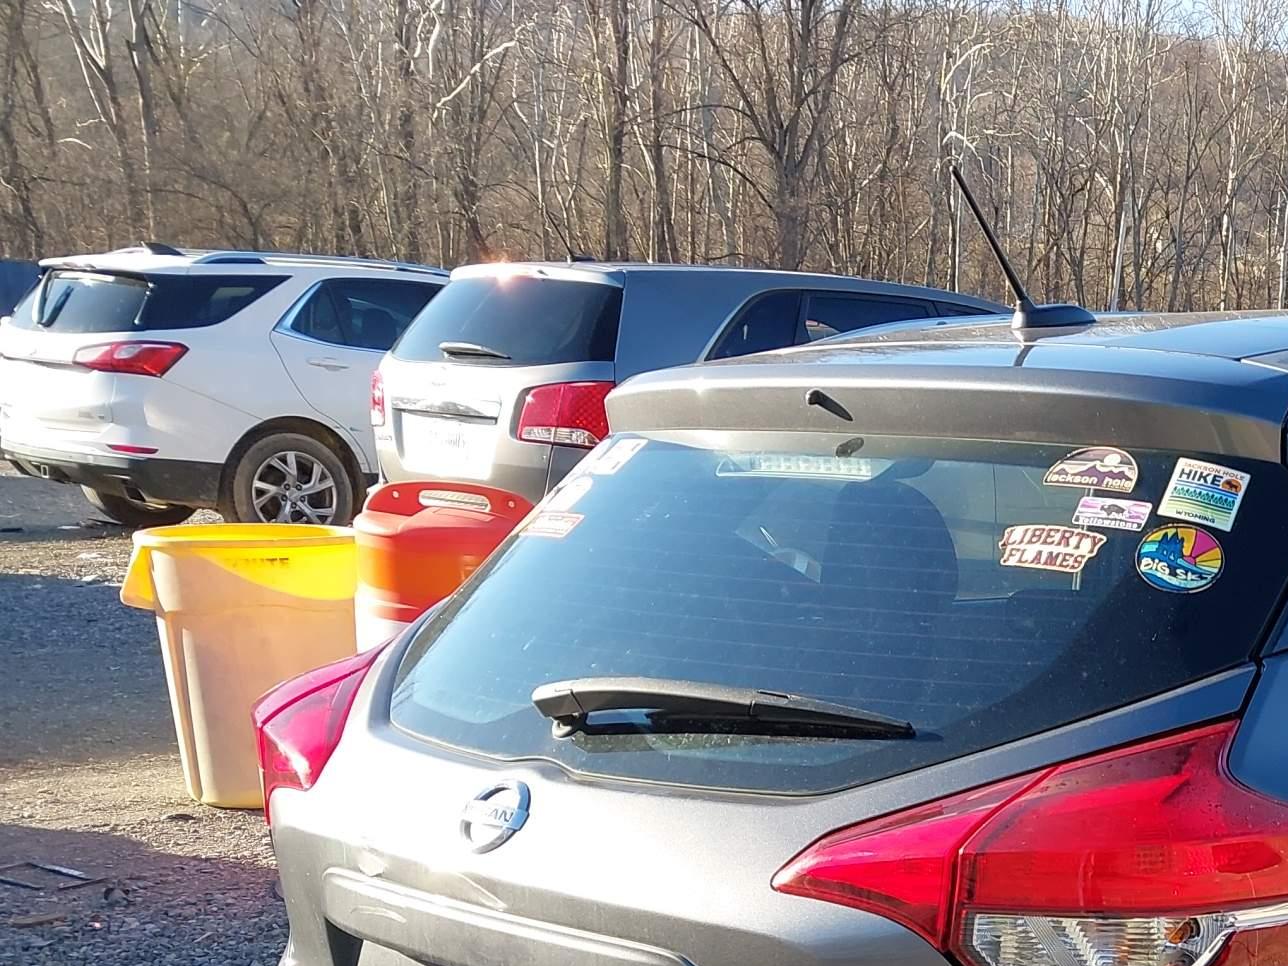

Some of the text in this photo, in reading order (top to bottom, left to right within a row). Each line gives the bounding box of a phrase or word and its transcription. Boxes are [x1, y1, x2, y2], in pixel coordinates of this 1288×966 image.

[1179, 468, 1223, 487] HIKE
[1001, 528, 1104, 554] LIBERTY
[1002, 548, 1086, 570] FLAMES
